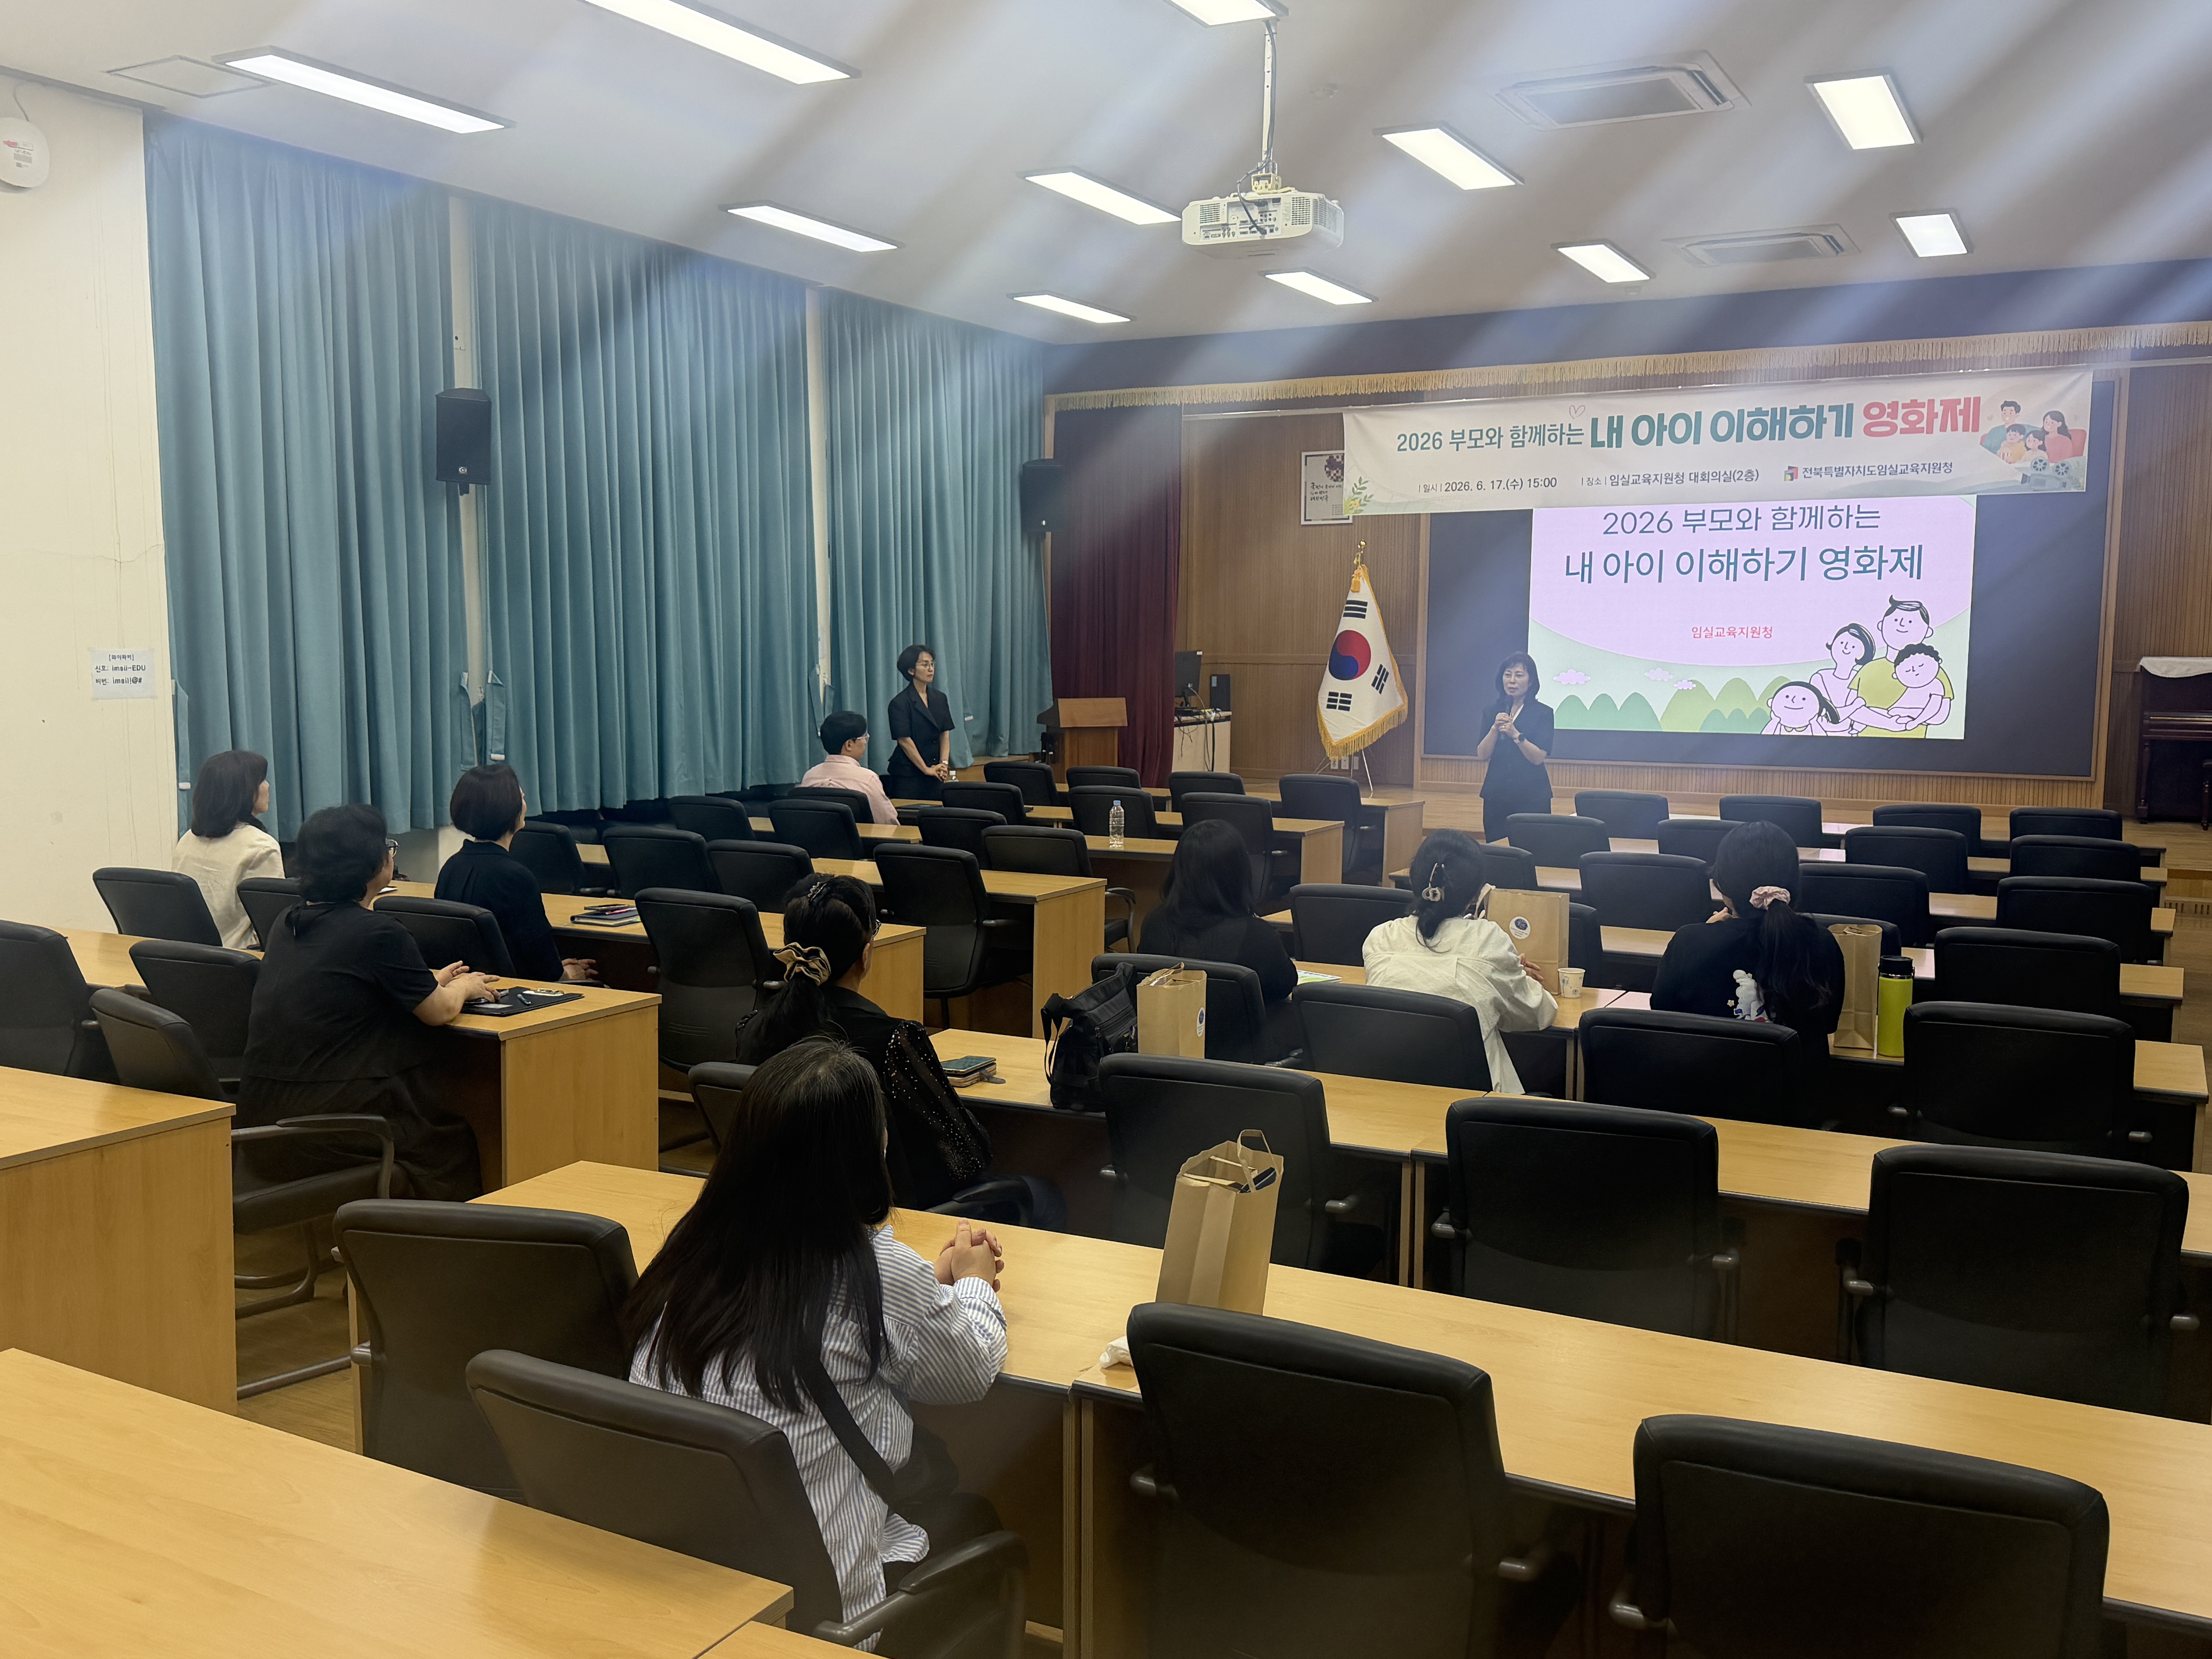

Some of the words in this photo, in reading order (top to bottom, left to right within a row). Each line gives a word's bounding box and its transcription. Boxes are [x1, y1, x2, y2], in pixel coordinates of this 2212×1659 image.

[1397, 432, 1443, 452] 2026
[1449, 427, 1503, 451] 부모와
[1510, 423, 1584, 448] 함께하는
[1591, 415, 1623, 448] 내
[1632, 411, 1702, 446] 아이
[1710, 403, 1854, 442] 이해하기
[1863, 397, 1980, 437] 영화제
[1609, 472, 1685, 486] 임실교육지원청
[1689, 469, 1759, 483] 대회의실(2층)
[1802, 462, 1953, 479] 전북특별자치도임실교육지원청
[1444, 481, 1473, 492] 2026.
[1476, 481, 1486, 491] 6.
[1490, 478, 1523, 490] 17.(수)
[1527, 477, 1557, 488] 15:00
[1603, 511, 1673, 534] 2026
[1682, 508, 1762, 533] 부모와
[1771, 505, 1881, 530] 함께하는
[1566, 551, 1593, 584] 내
[1603, 550, 1663, 583] 아이
[1676, 547, 1806, 582] 이해하기
[1819, 545, 1923, 580] 영화제
[1692, 626, 1772, 639] 임실교육지원청
